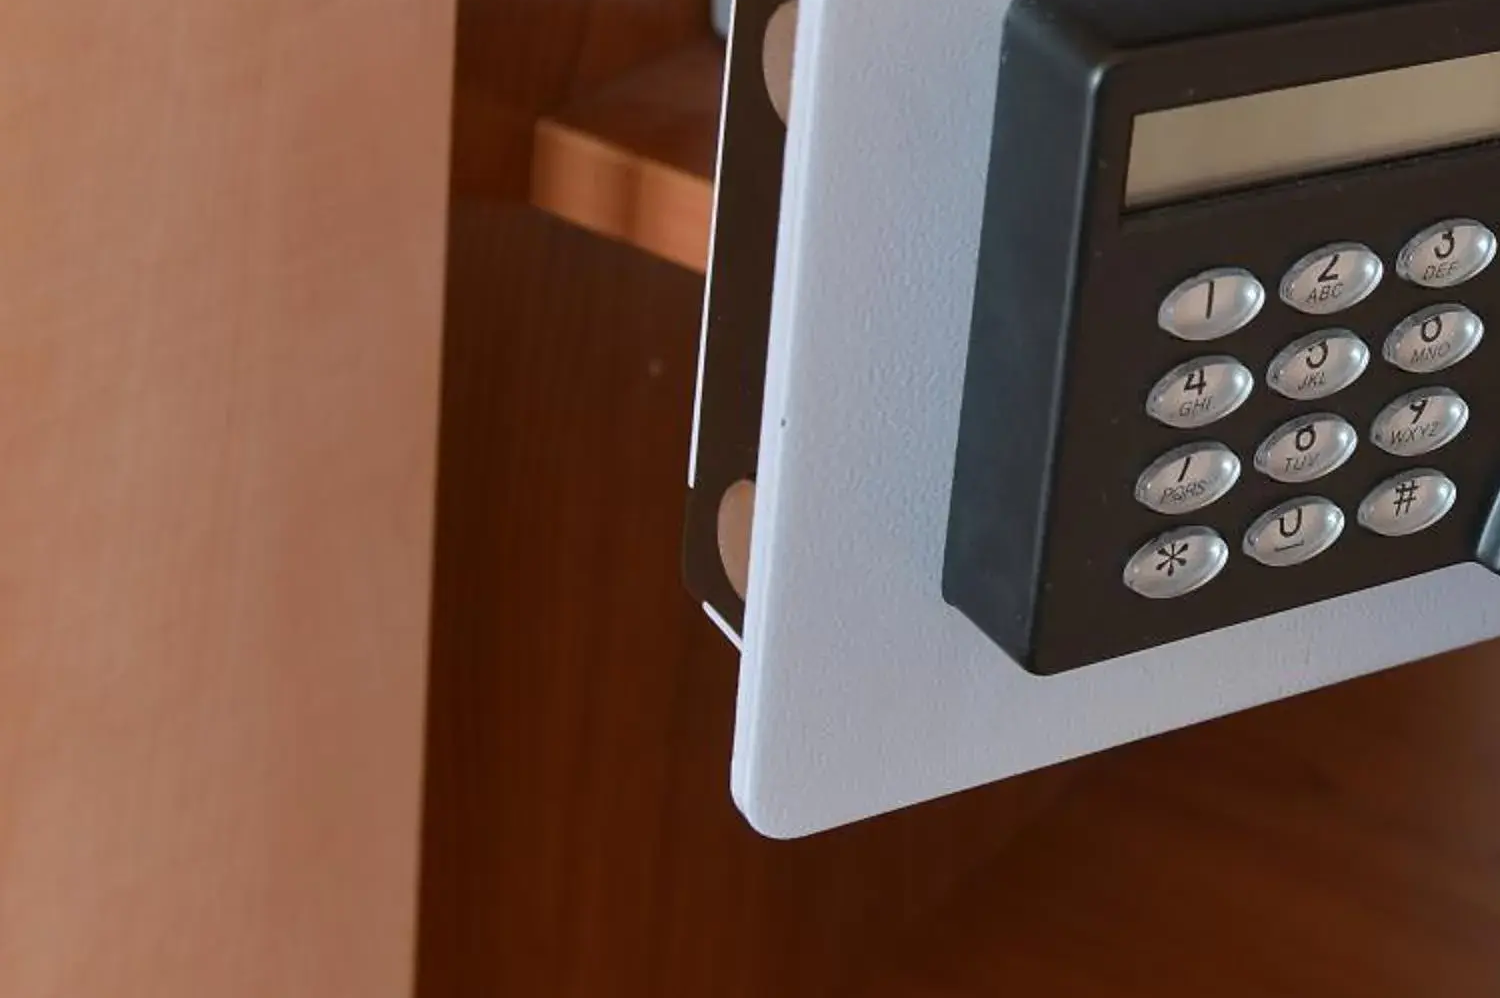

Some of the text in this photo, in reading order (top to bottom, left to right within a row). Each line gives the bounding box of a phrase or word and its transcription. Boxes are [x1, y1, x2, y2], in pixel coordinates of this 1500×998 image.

[1423, 261, 1459, 281] DEF
[1305, 283, 1344, 303] ABC
[1183, 368, 1207, 396] 4
